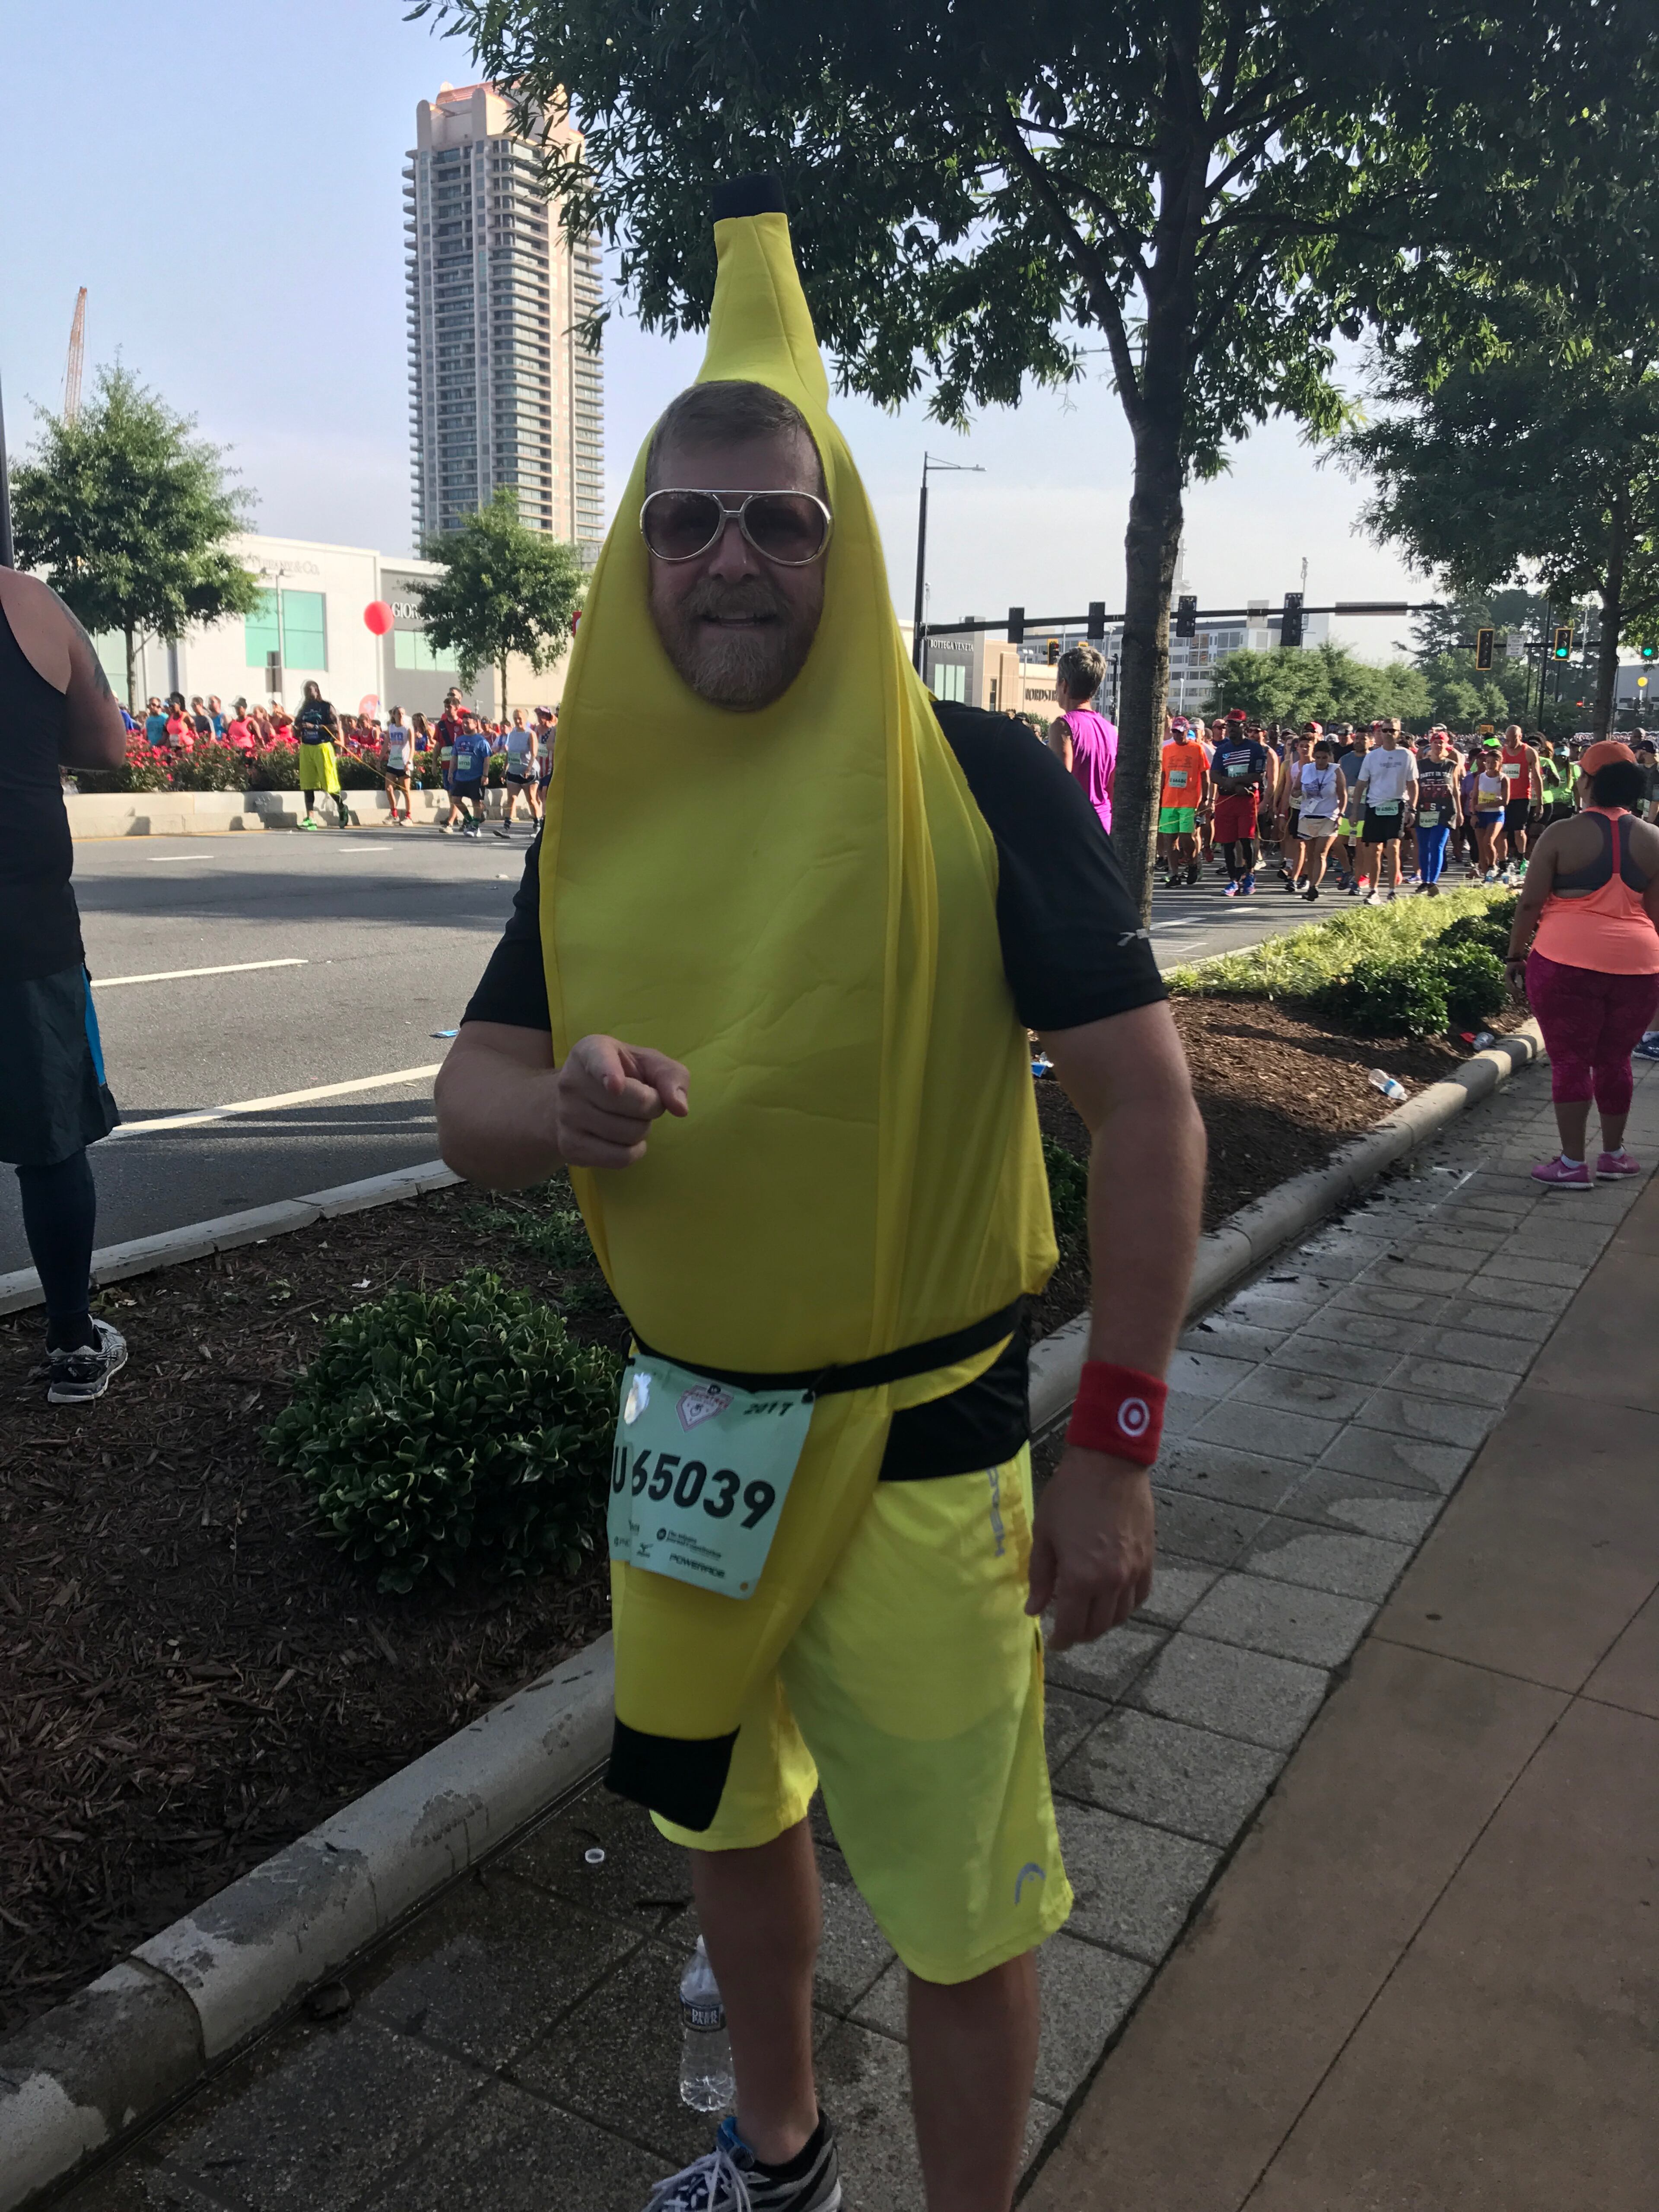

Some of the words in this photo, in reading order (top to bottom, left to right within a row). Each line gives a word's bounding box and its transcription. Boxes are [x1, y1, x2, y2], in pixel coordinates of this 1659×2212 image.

[930, 639, 953, 650] BOTTEGA
[954, 642, 974, 652] VENETA
[1025, 688, 1058, 702] NORDSTR
[743, 1401, 794, 1417] 2017
[631, 1449, 776, 1529] 65039
[692, 2009, 718, 2017] DEER
[692, 2016, 718, 2025] PARK
